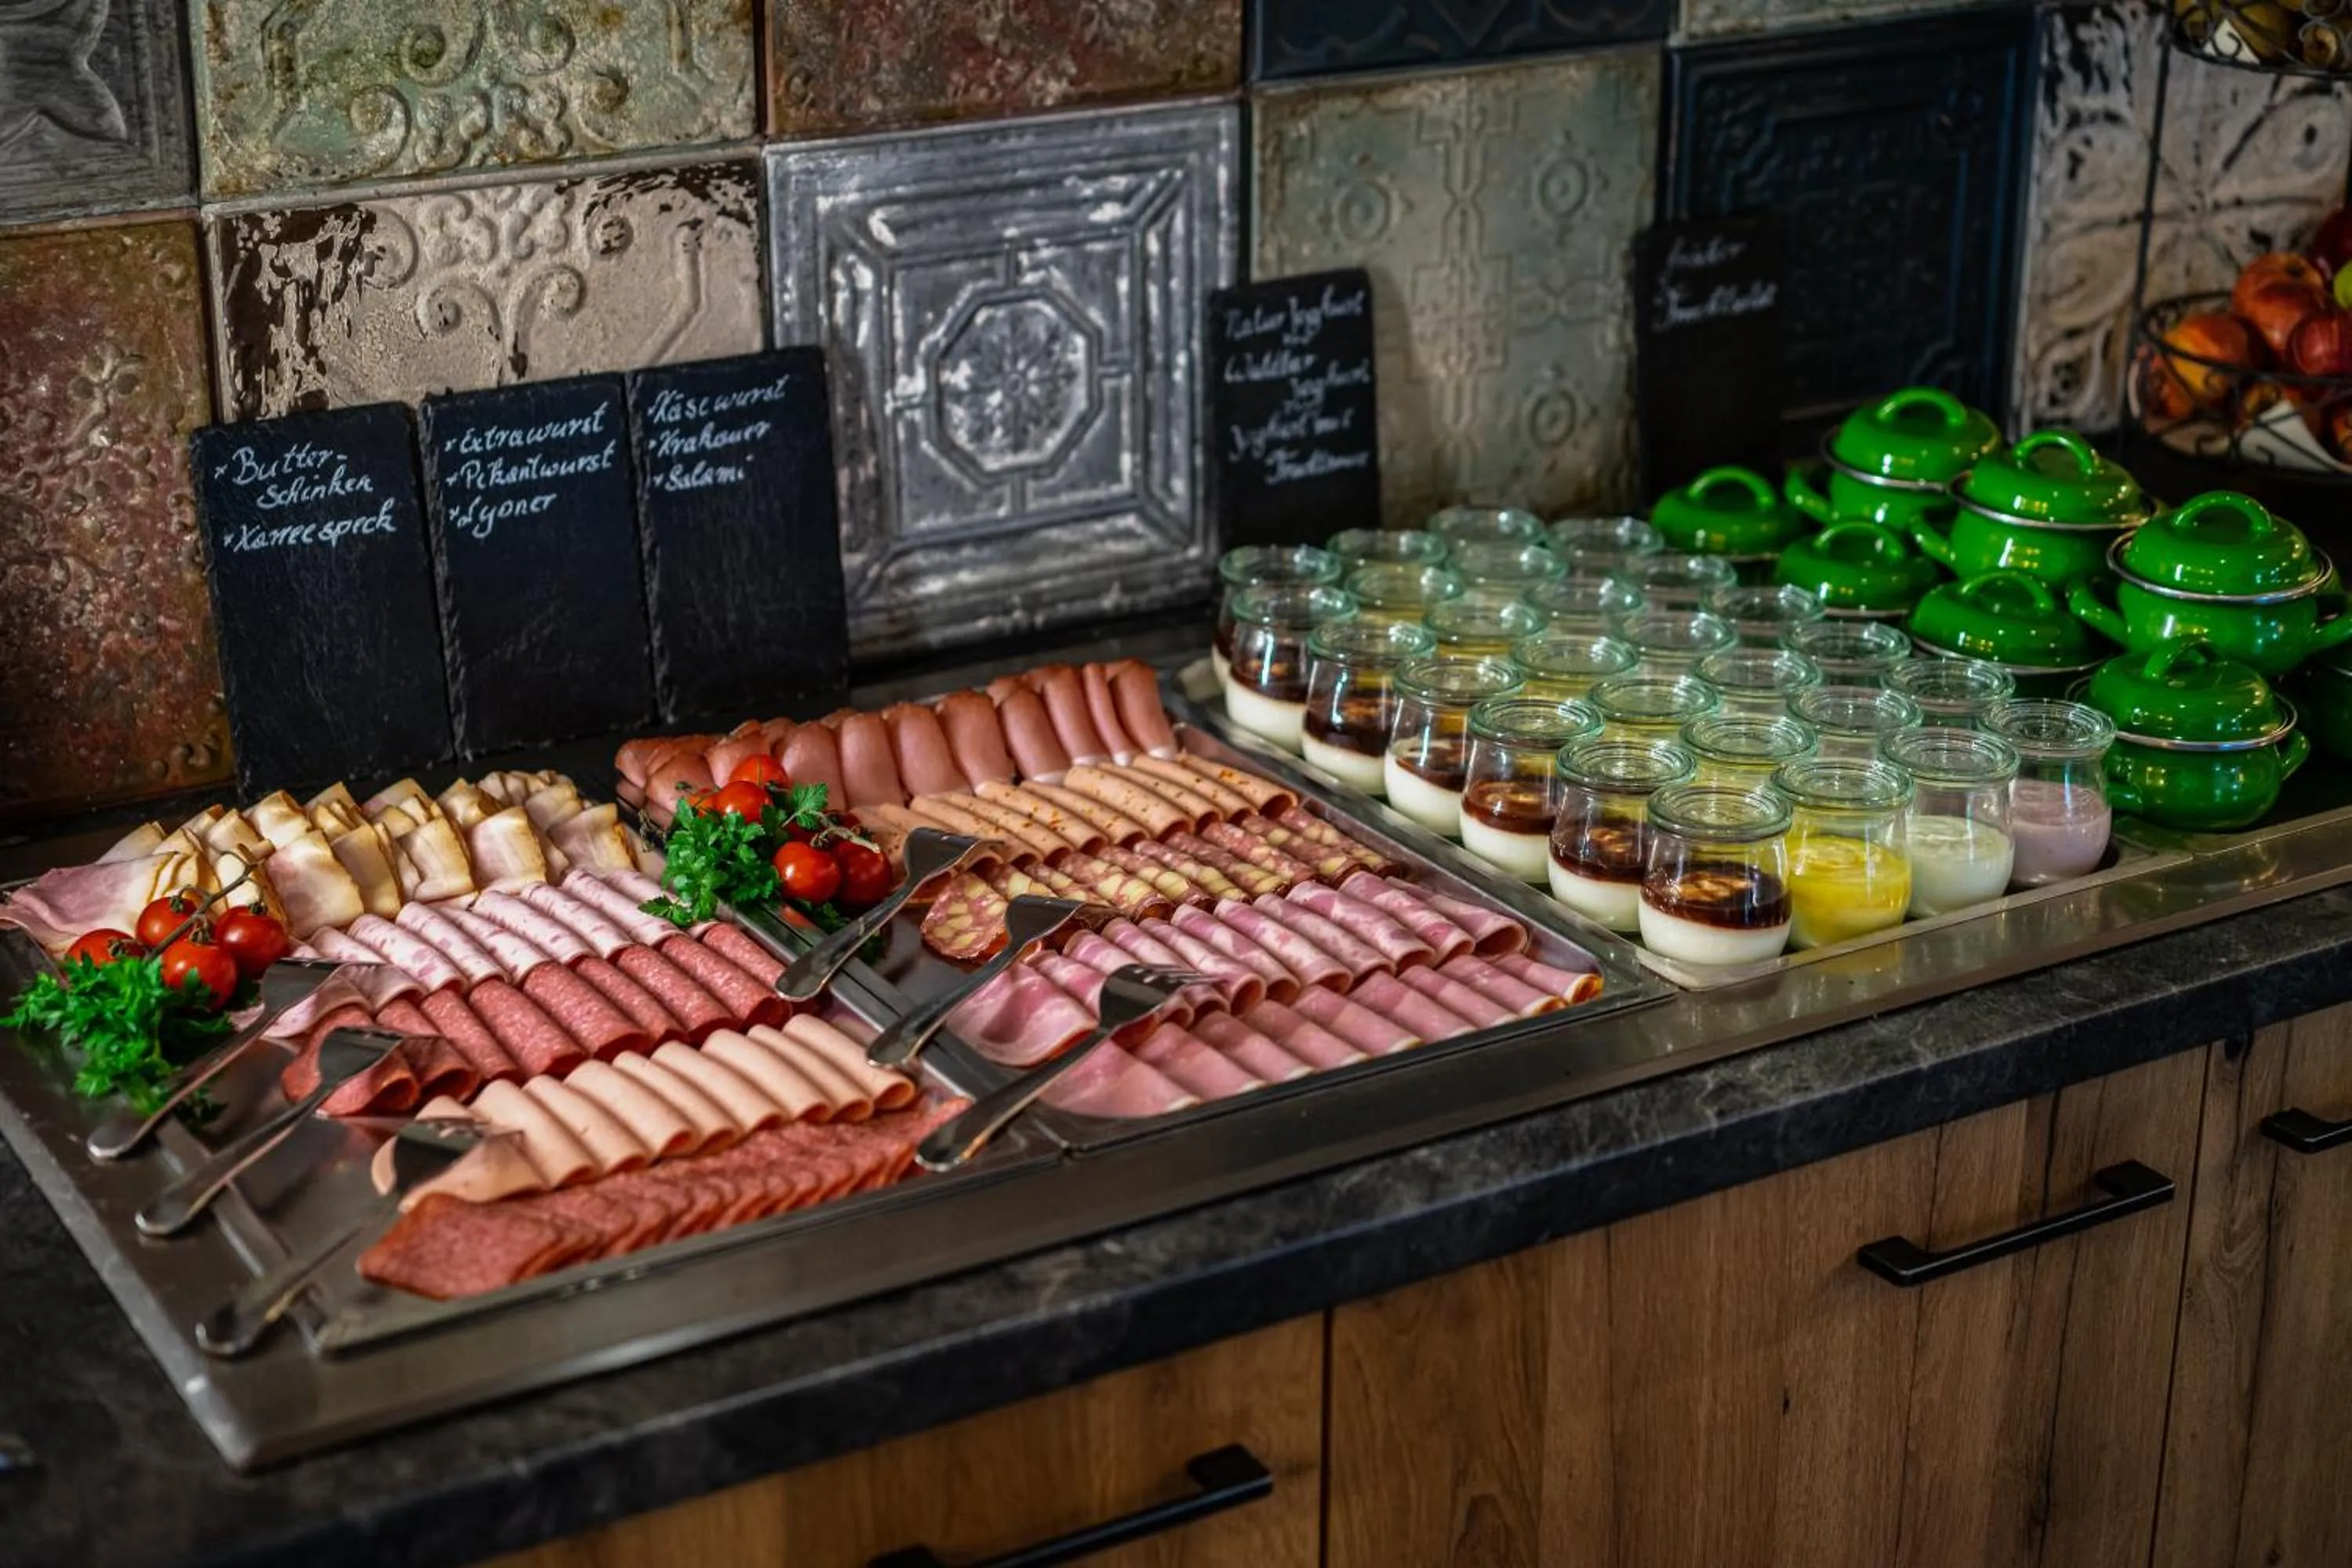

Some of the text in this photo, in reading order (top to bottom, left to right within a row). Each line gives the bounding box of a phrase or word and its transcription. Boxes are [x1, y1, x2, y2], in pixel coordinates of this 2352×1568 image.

[652, 373, 790, 424] Käsewurst
[459, 401, 609, 454] Extrawurst
[657, 420, 771, 458] Krakauer
[232, 441, 347, 485] Butter-
[460, 438, 617, 489] Pikantwurst
[664, 454, 754, 492] Salami
[256, 464, 374, 510] Schinken
[457, 495, 557, 539] Lyoner
